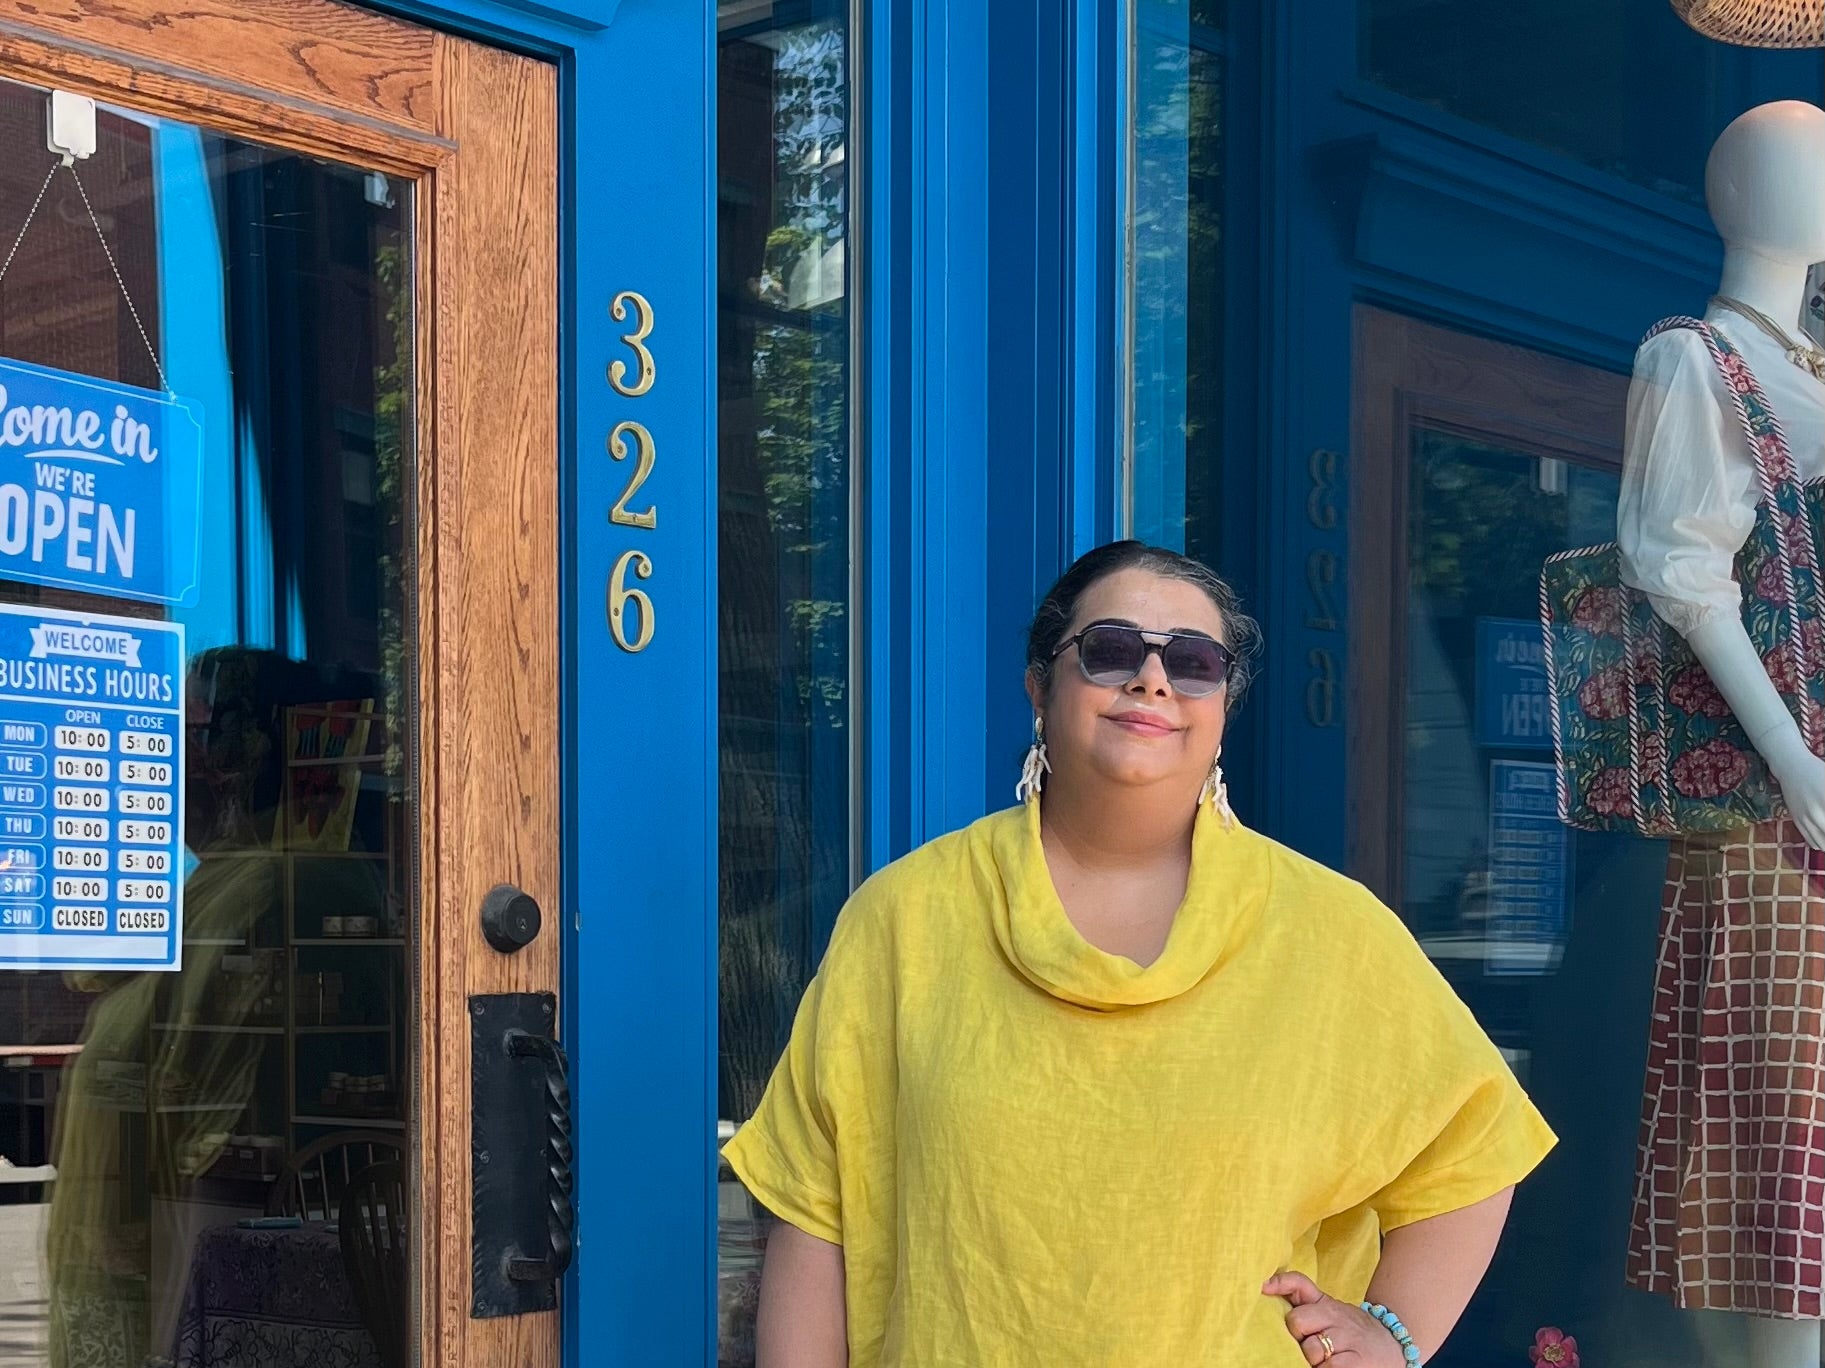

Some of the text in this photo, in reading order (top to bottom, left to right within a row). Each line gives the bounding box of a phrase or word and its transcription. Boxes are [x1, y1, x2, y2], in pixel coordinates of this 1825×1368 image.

[111, 404, 158, 463] in
[35, 462, 95, 496] WE'RE
[606, 290, 656, 652] 326
[0, 483, 135, 578] OPEN
[45, 630, 128, 655] WELCOME
[105, 669, 172, 702] HOURS
[65, 709, 165, 729] OPEN CLOSE
[4, 725, 35, 742] MON
[6, 756, 33, 772] TUE
[3, 786, 35, 803] WED
[5, 817, 32, 833] THU
[8, 848, 30, 864] FRI
[4, 877, 32, 893] SAT
[3, 909, 165, 929] SUN CLOSED CLOSED
